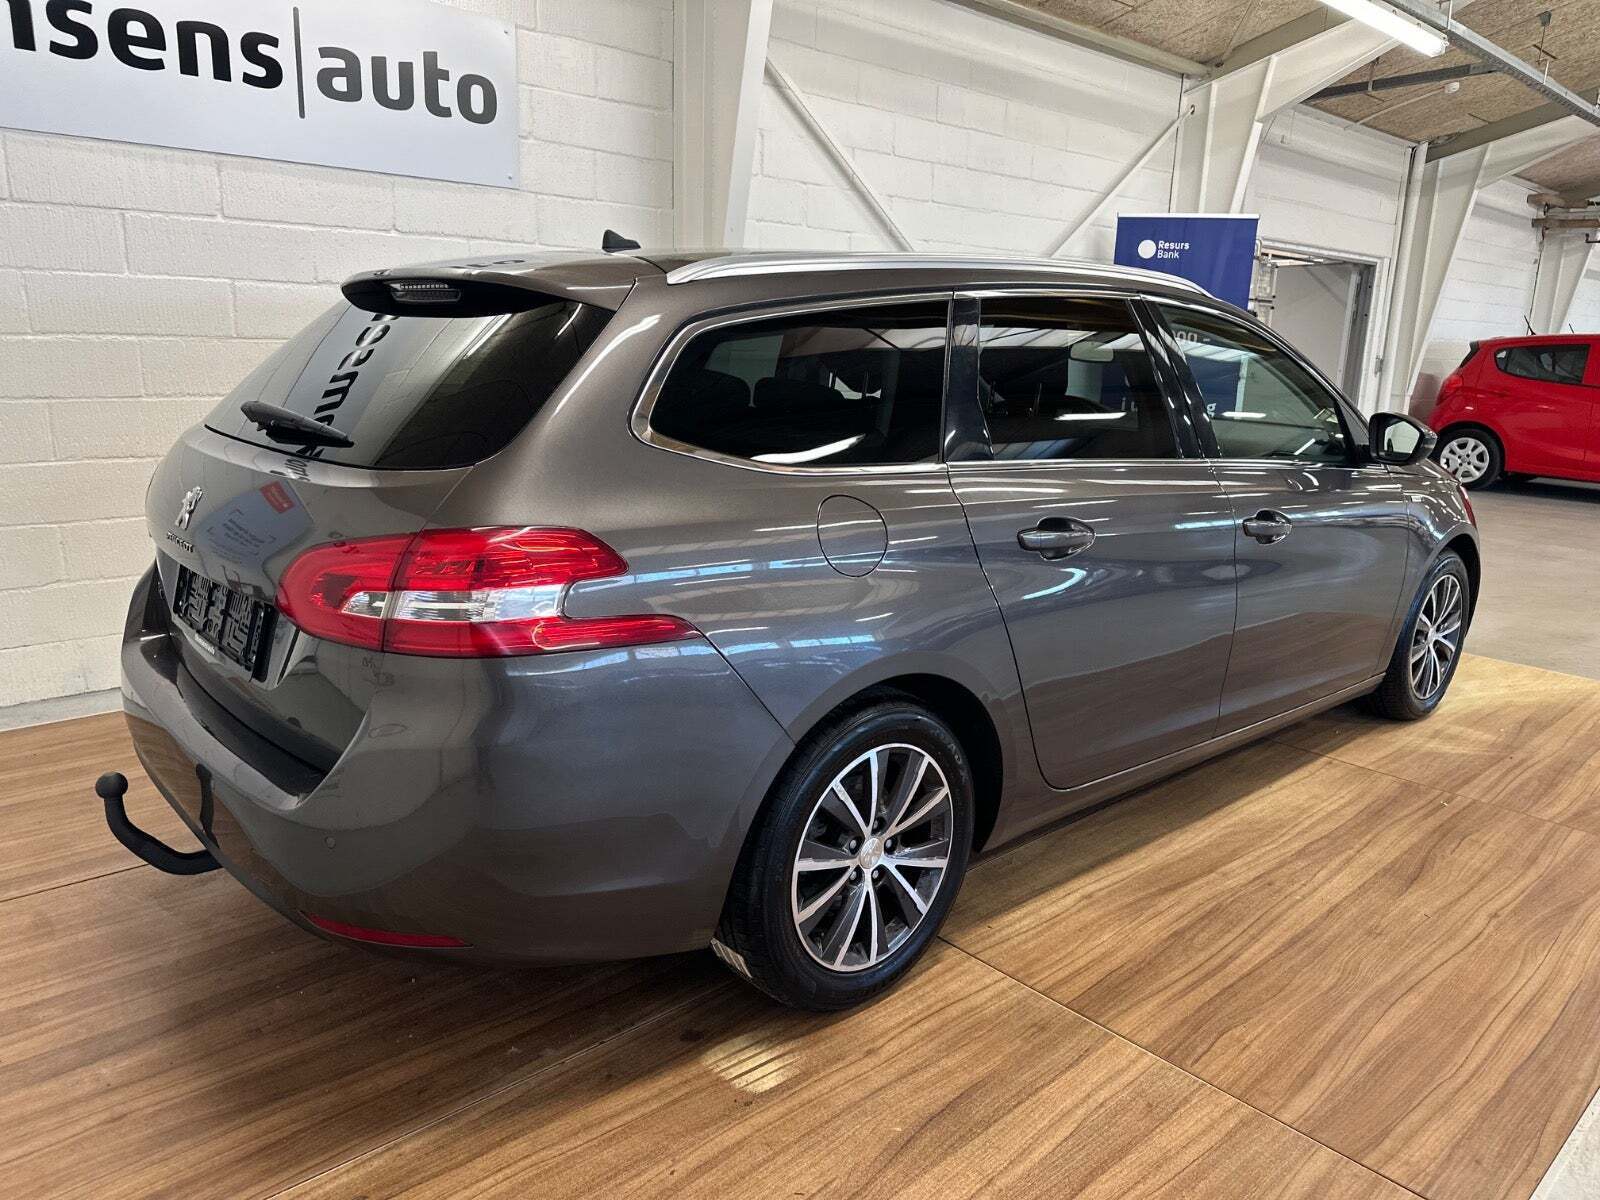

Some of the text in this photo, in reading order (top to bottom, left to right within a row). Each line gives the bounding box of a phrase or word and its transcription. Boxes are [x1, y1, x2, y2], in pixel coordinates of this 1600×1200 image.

[316, 47, 498, 125] auto
[1157, 240, 1190, 250] Resurs
[1156, 249, 1180, 259] Bank
